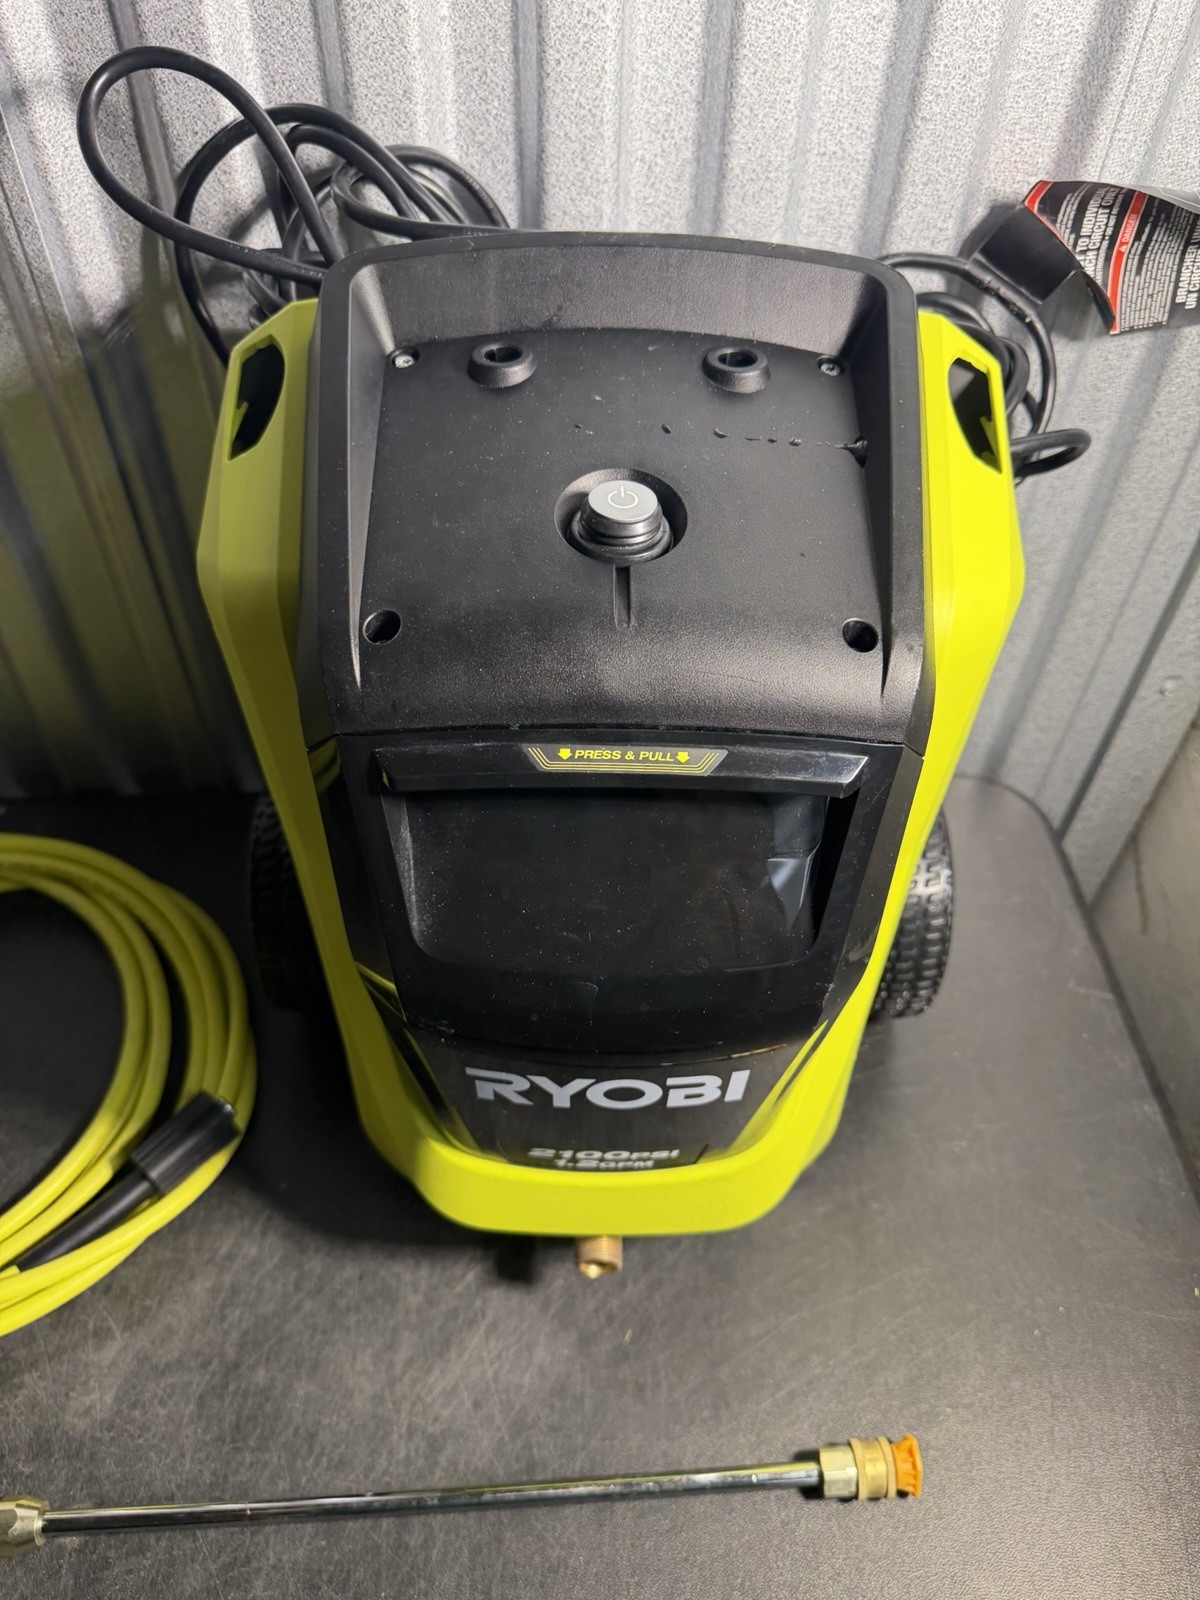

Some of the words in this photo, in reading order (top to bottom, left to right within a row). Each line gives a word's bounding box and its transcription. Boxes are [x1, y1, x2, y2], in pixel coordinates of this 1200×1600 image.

[1080, 187, 1109, 236] INDIVIDUAL
[1088, 207, 1110, 250] CIRCUIT
[1121, 213, 1138, 243] DANGER
[1076, 236, 1089, 252] TO
[1175, 244, 1199, 304] BRANCHER
[1185, 290, 1199, 310] UN
[574, 749, 622, 760] PRESS
[625, 750, 635, 761] &
[639, 751, 674, 762] PULL
[465, 1067, 751, 1110] RYOBI
